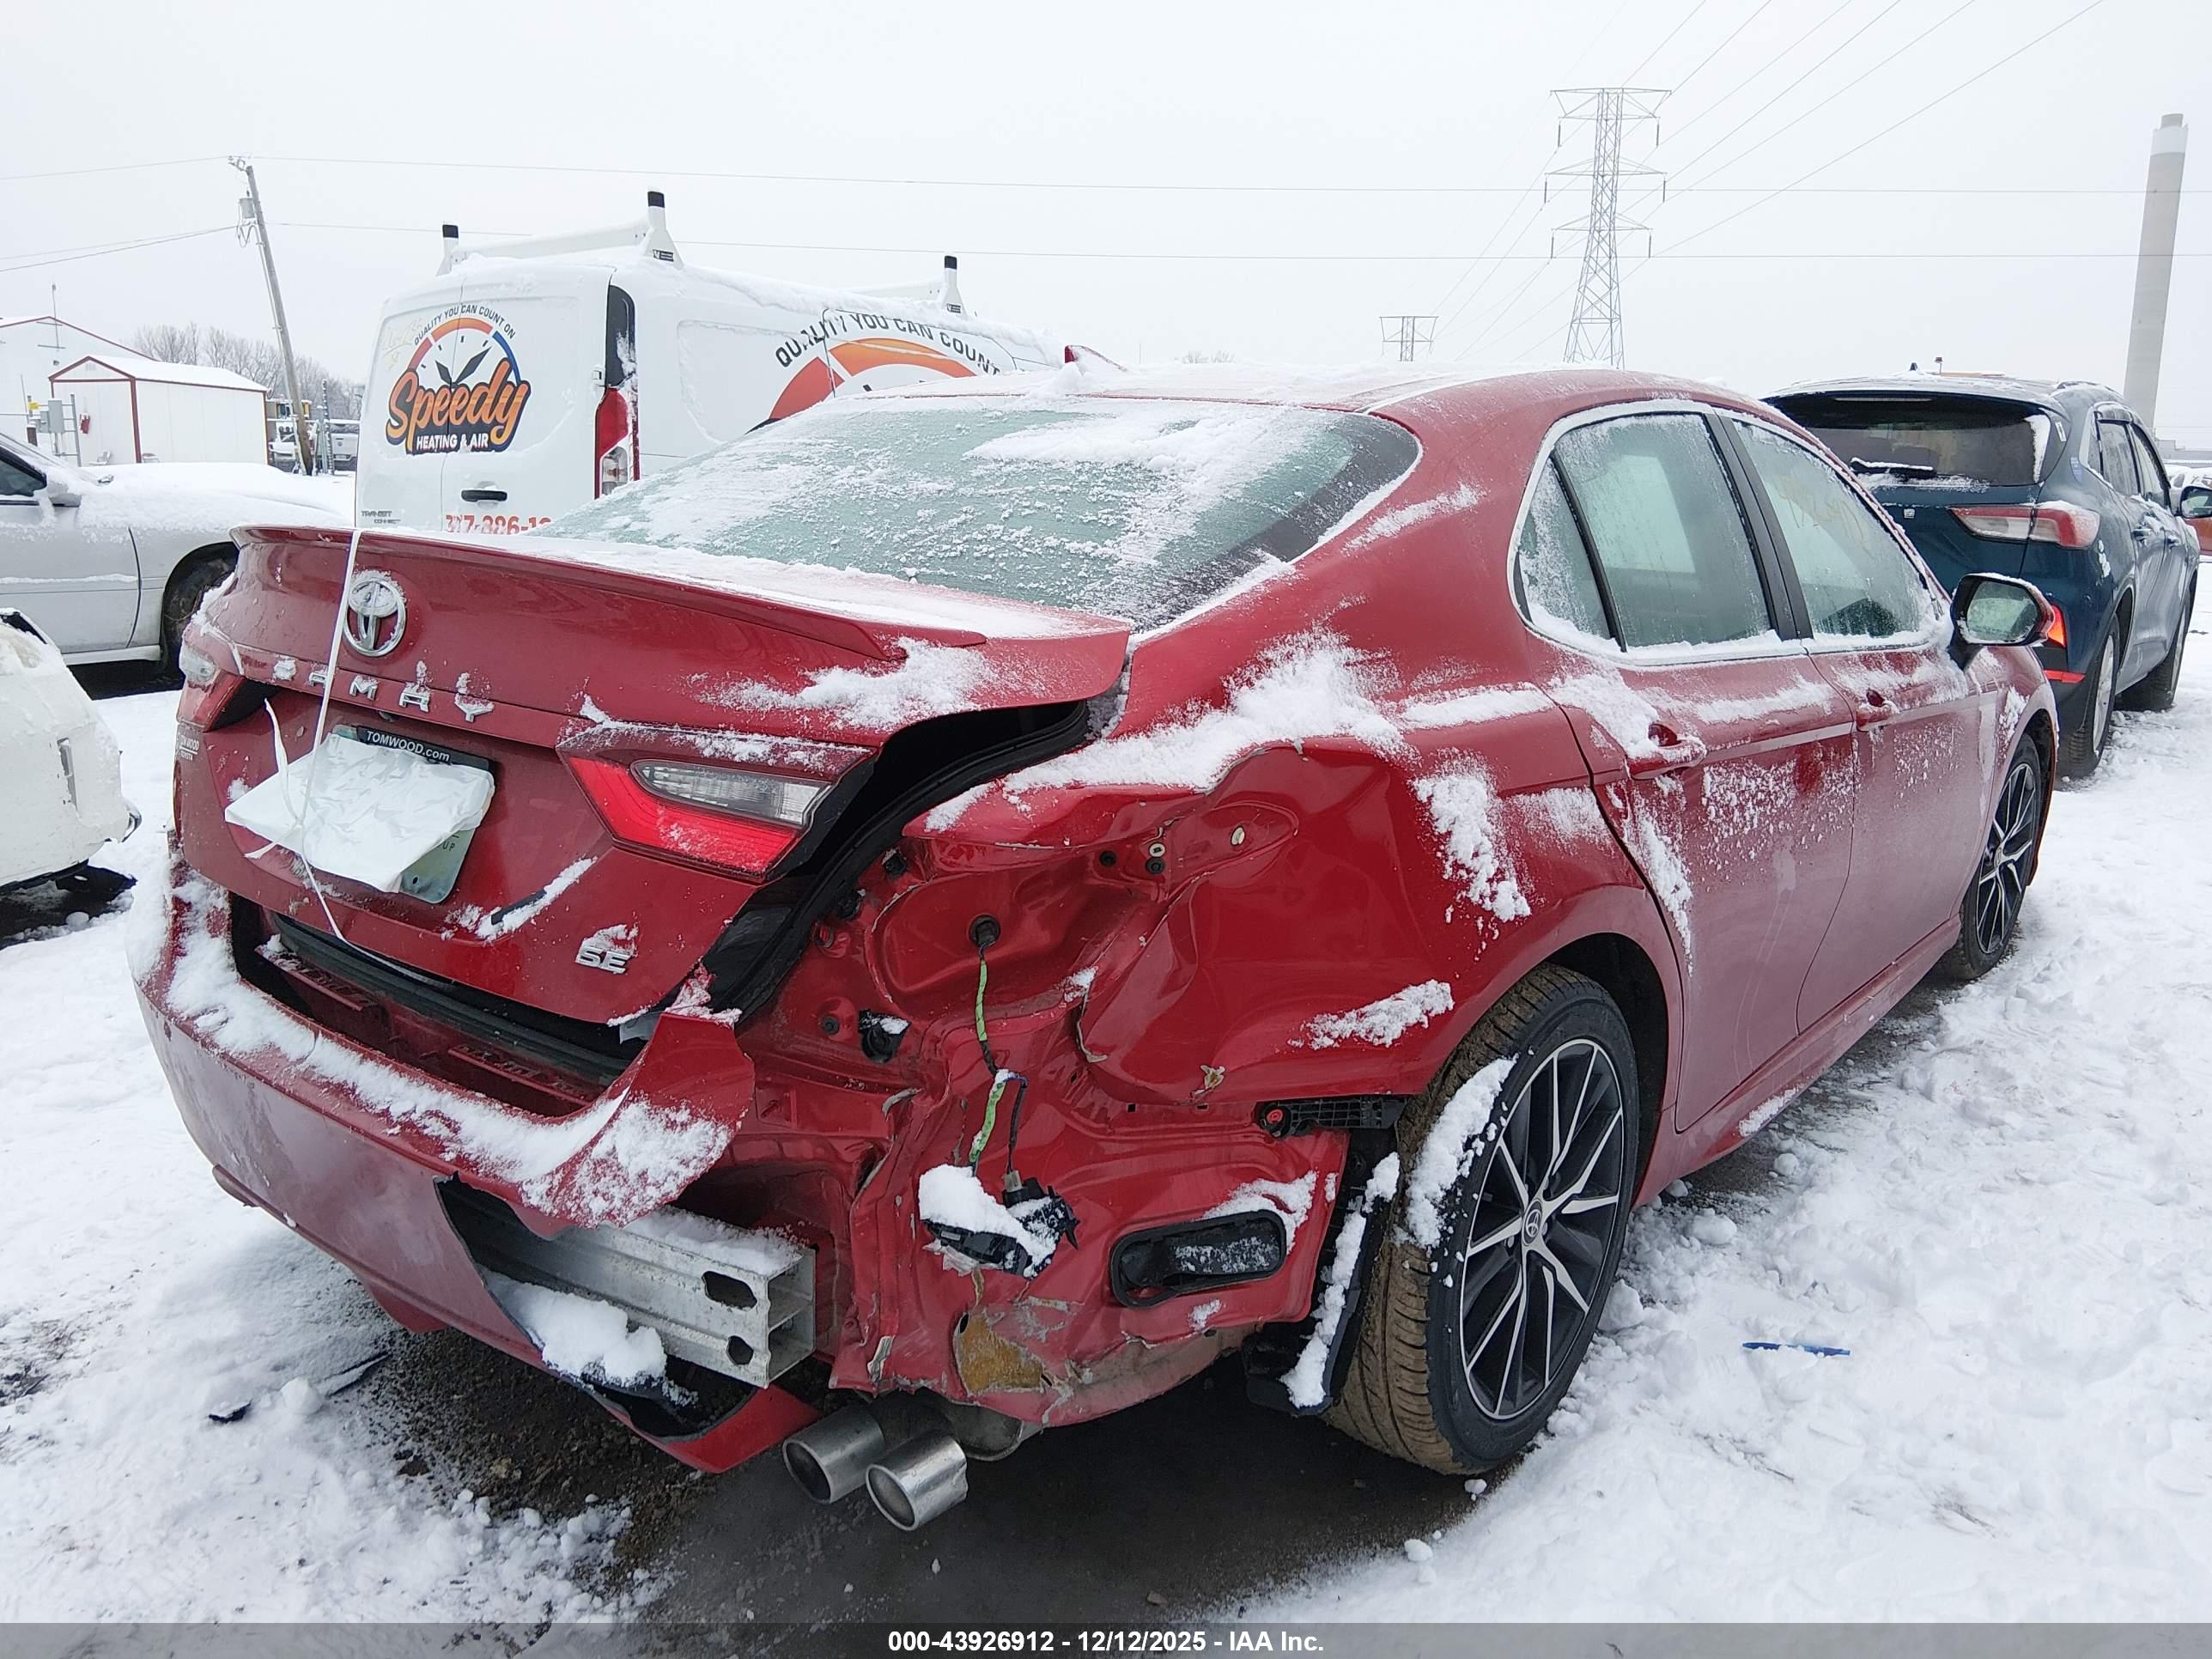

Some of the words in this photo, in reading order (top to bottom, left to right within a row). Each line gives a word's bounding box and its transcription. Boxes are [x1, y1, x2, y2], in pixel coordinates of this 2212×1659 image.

[414, 313, 443, 345] QUALITY
[444, 306, 459, 319] YOU
[460, 304, 477, 314] CAN
[478, 306, 505, 326] COUNT
[503, 323, 516, 339] ON
[849, 313, 889, 330] YOU
[893, 318, 934, 340] CAN
[386, 358, 530, 453] Speedy
[416, 434, 459, 451] HEATING
[470, 432, 489, 448] AIR
[367, 730, 450, 762] TOMWOOD.com
[574, 945, 632, 975] SE
